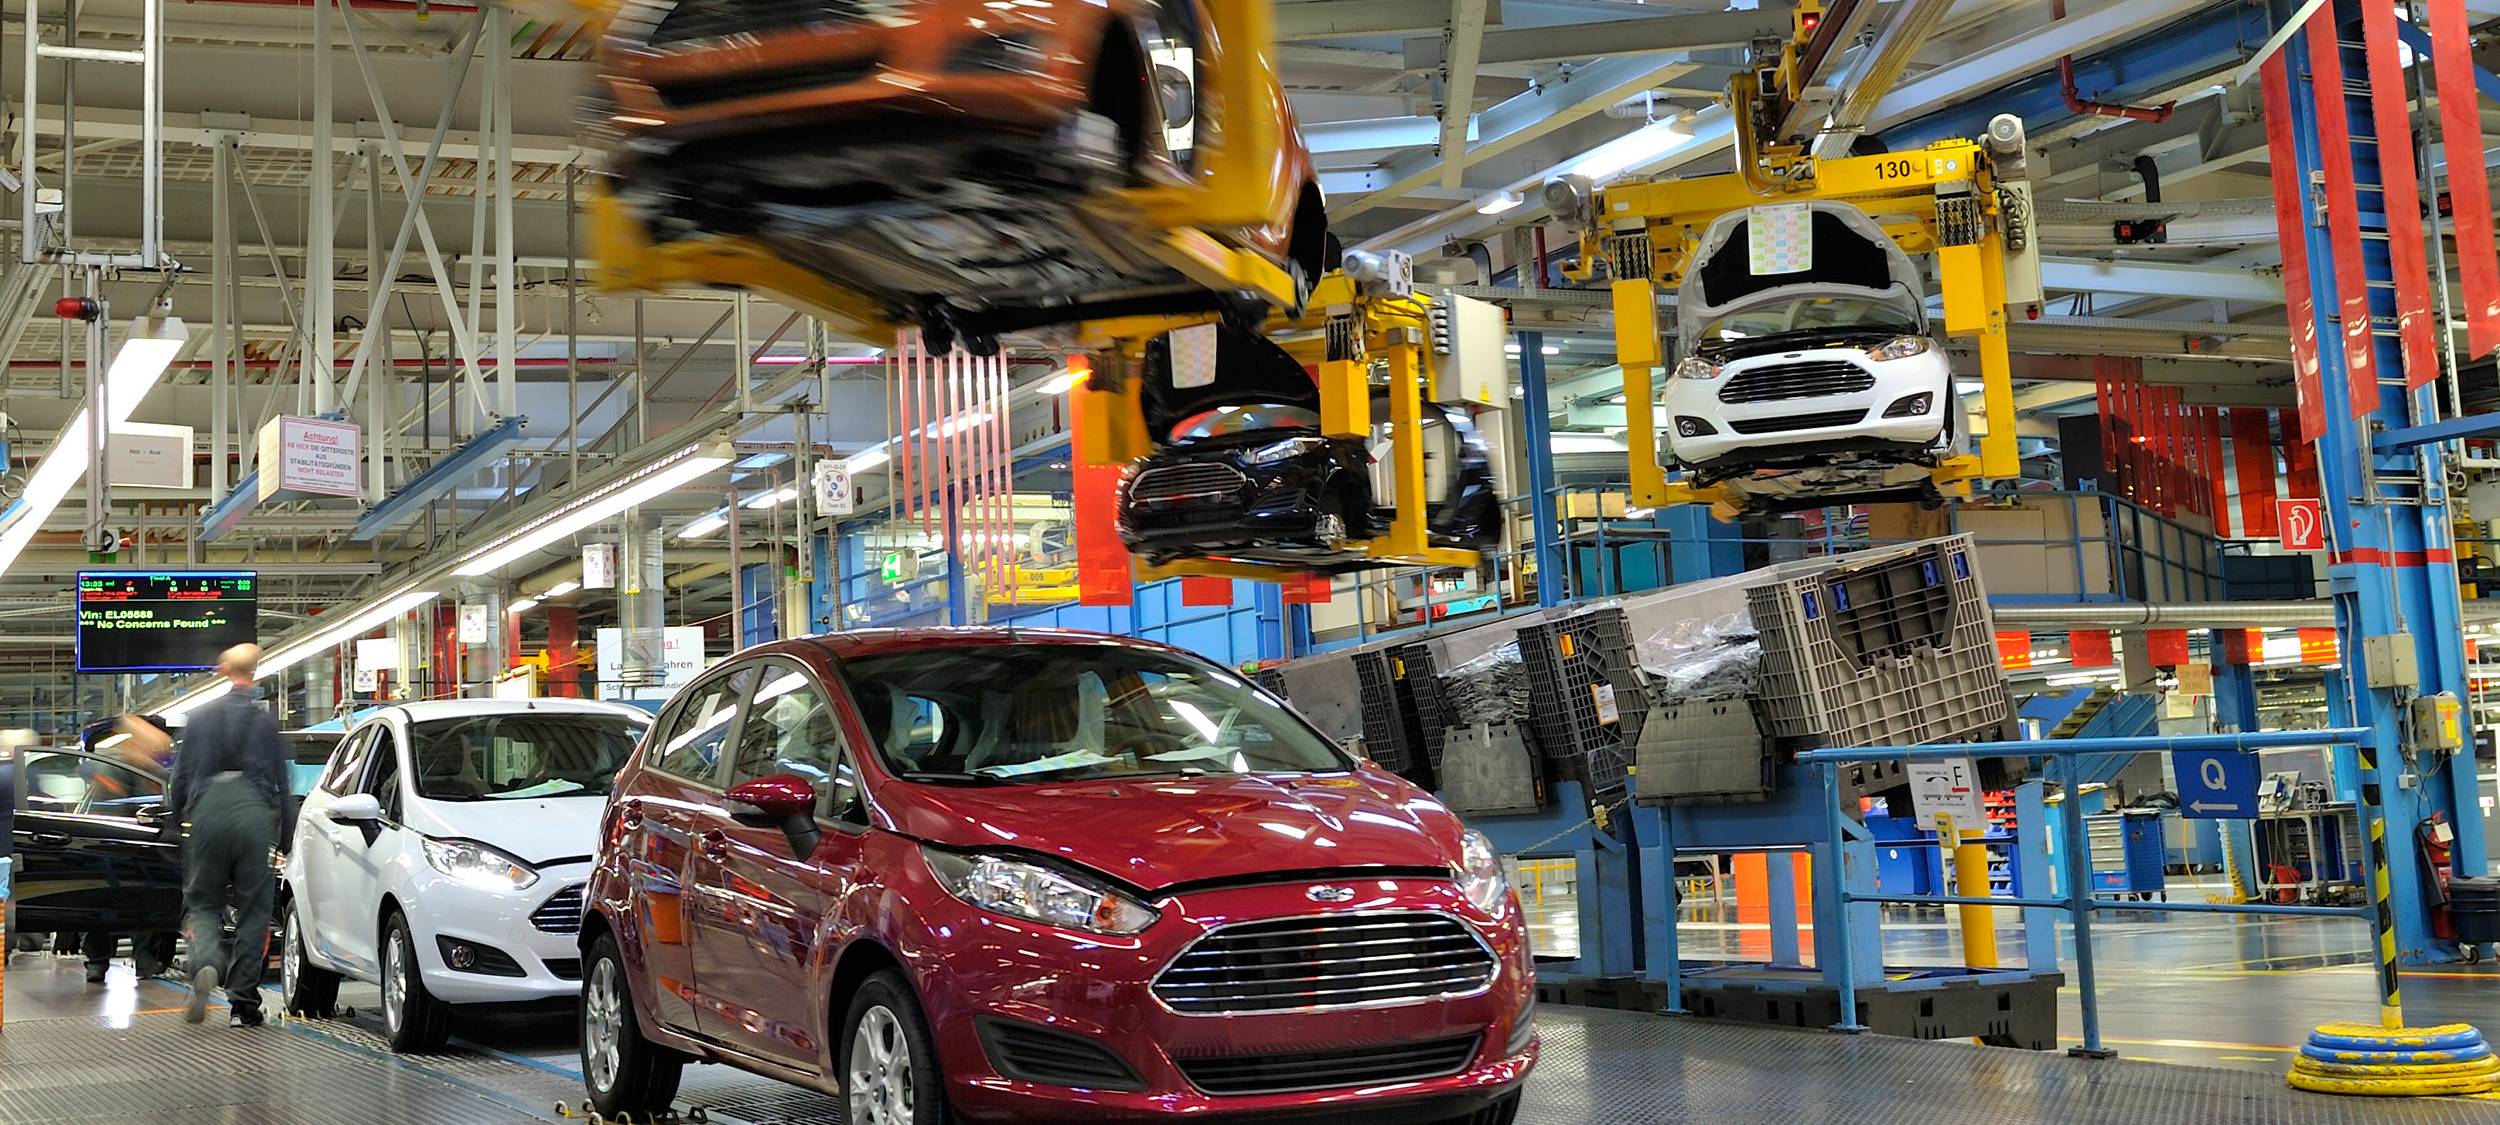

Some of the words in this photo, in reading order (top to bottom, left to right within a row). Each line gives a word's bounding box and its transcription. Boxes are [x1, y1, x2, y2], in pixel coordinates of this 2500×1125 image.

[1874, 160, 1910, 179] 130
[96, 620, 114, 629] No
[115, 619, 171, 629] Concerns
[173, 619, 209, 628] Found
[664, 660, 693, 669] ahren
[1953, 766, 1963, 787] F
[2200, 758, 2227, 791] Q
